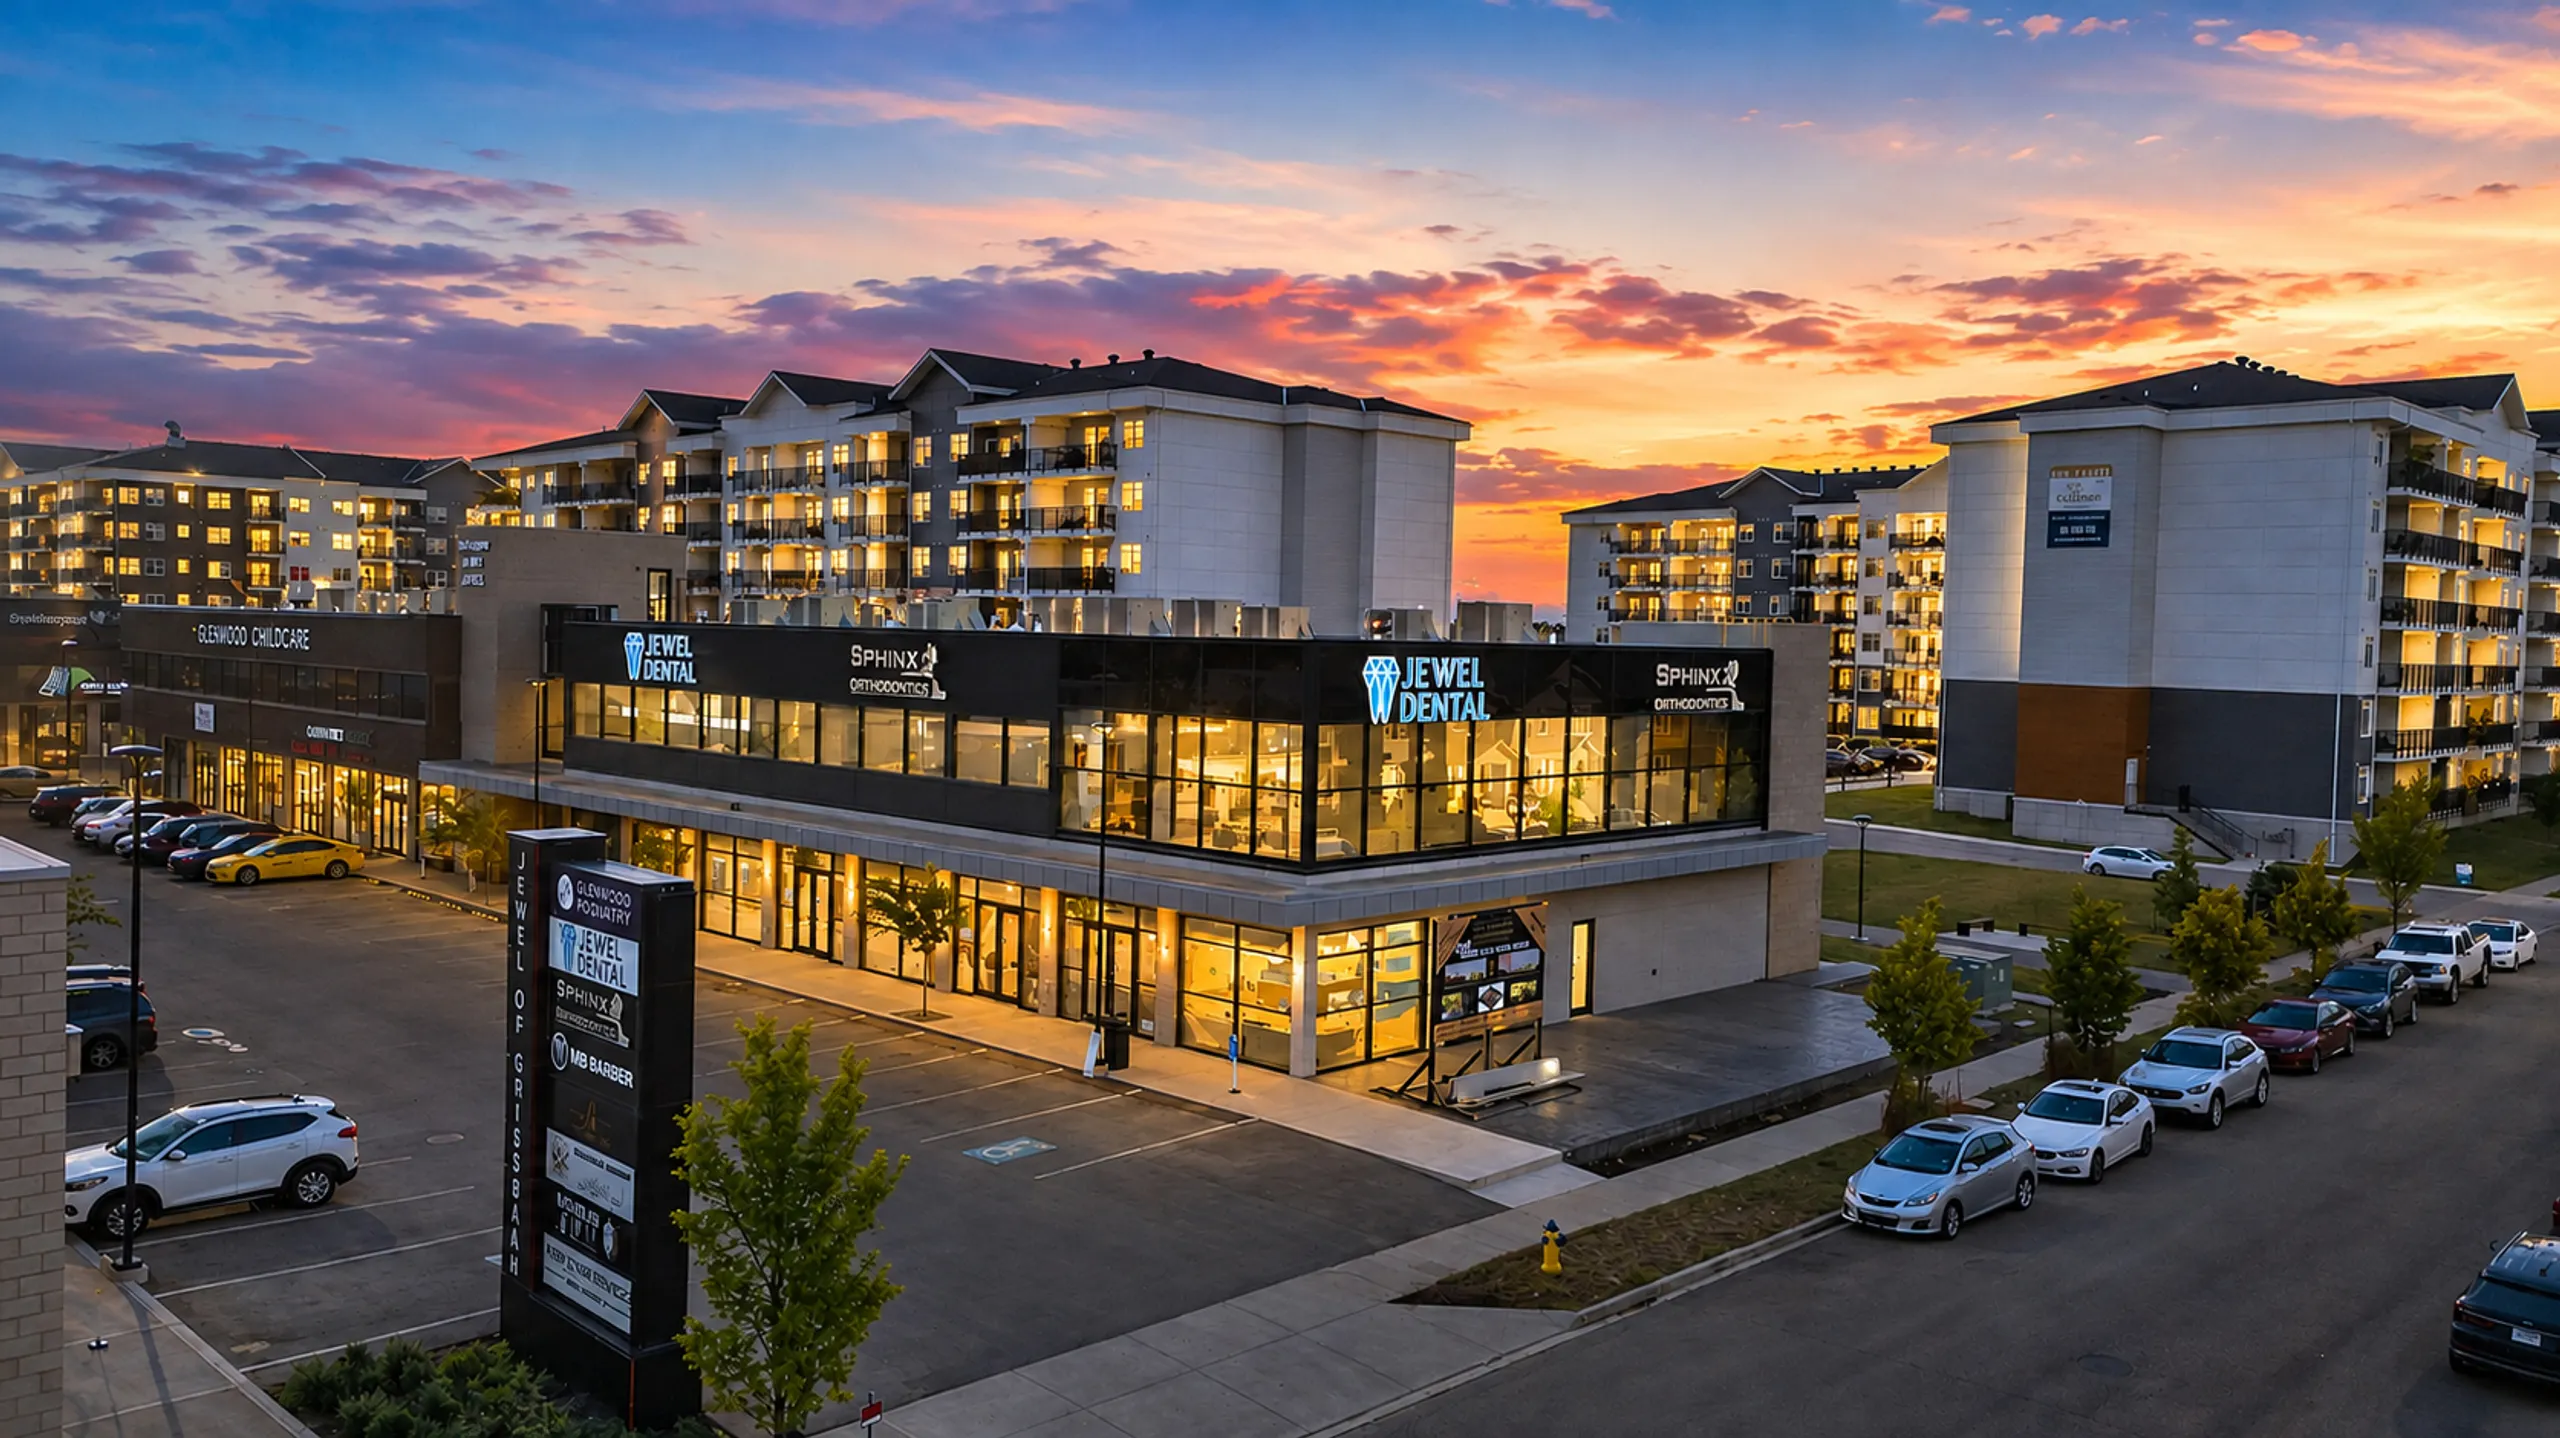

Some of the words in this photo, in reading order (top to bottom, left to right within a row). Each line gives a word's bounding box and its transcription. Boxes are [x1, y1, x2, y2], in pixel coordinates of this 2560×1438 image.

[198, 624, 247, 646] GLENWOOD
[251, 626, 310, 650] CHILDCARE
[644, 633, 693, 658] JEWEL
[643, 658, 697, 683] DENTAL
[851, 644, 918, 669] SPHINX
[1401, 656, 1484, 689] JEWEL
[1656, 663, 1721, 686] SPHINX
[1400, 691, 1491, 723] DENTAL
[514, 851, 527, 972] JEWEL
[579, 929, 622, 961] JEWEL
[577, 952, 627, 988] DENTAL
[514, 989, 525, 1034] OF
[557, 979, 608, 1014] SPHINX
[570, 1047, 588, 1069] MB
[589, 1056, 633, 1088] BARBER
